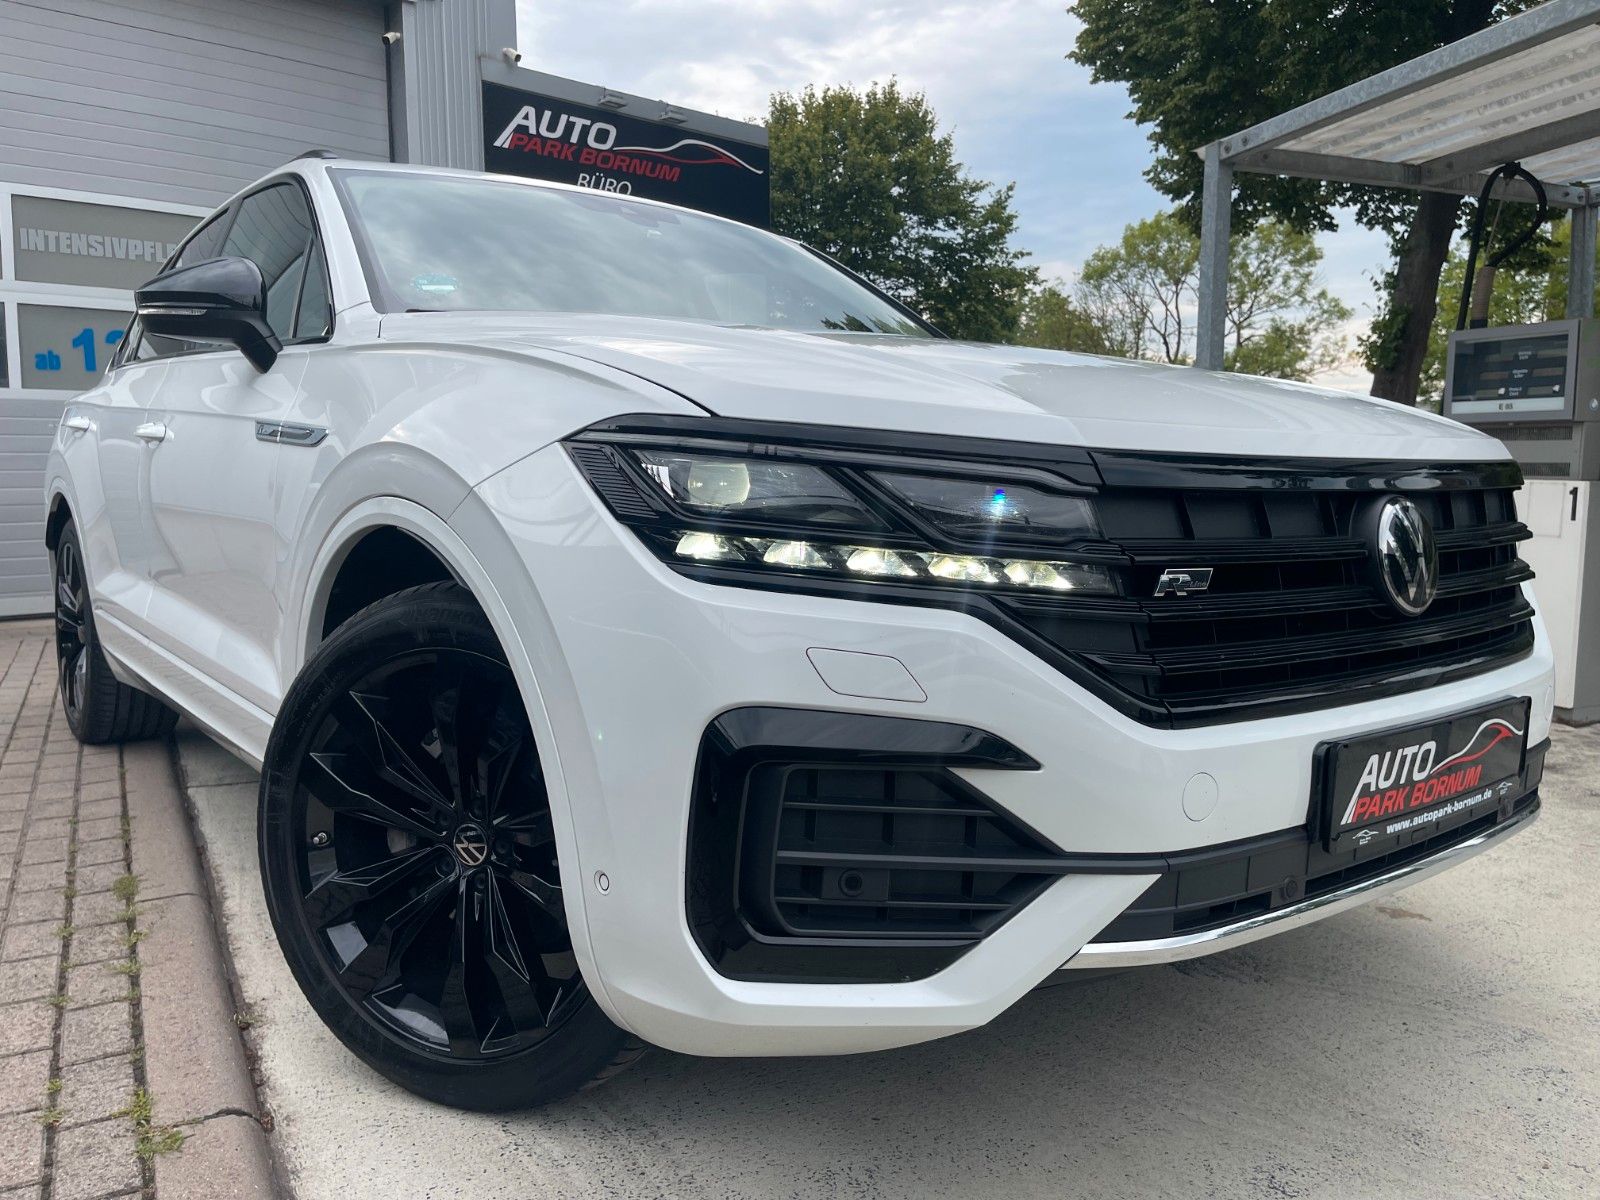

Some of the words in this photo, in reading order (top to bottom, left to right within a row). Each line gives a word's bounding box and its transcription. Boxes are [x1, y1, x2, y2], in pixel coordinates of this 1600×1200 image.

[493, 105, 617, 149] AUTO
[509, 133, 578, 161] PARK
[579, 148, 681, 182] BORNUM
[577, 172, 632, 195] BÜRO
[35, 350, 61, 371] ab
[1569, 487, 1578, 521] 1
[1340, 740, 1437, 825] AUTO
[1352, 786, 1409, 824] PARK
[1410, 765, 1483, 807] BORNUM
[1386, 789, 1493, 834] www.autopark-bornum.de
